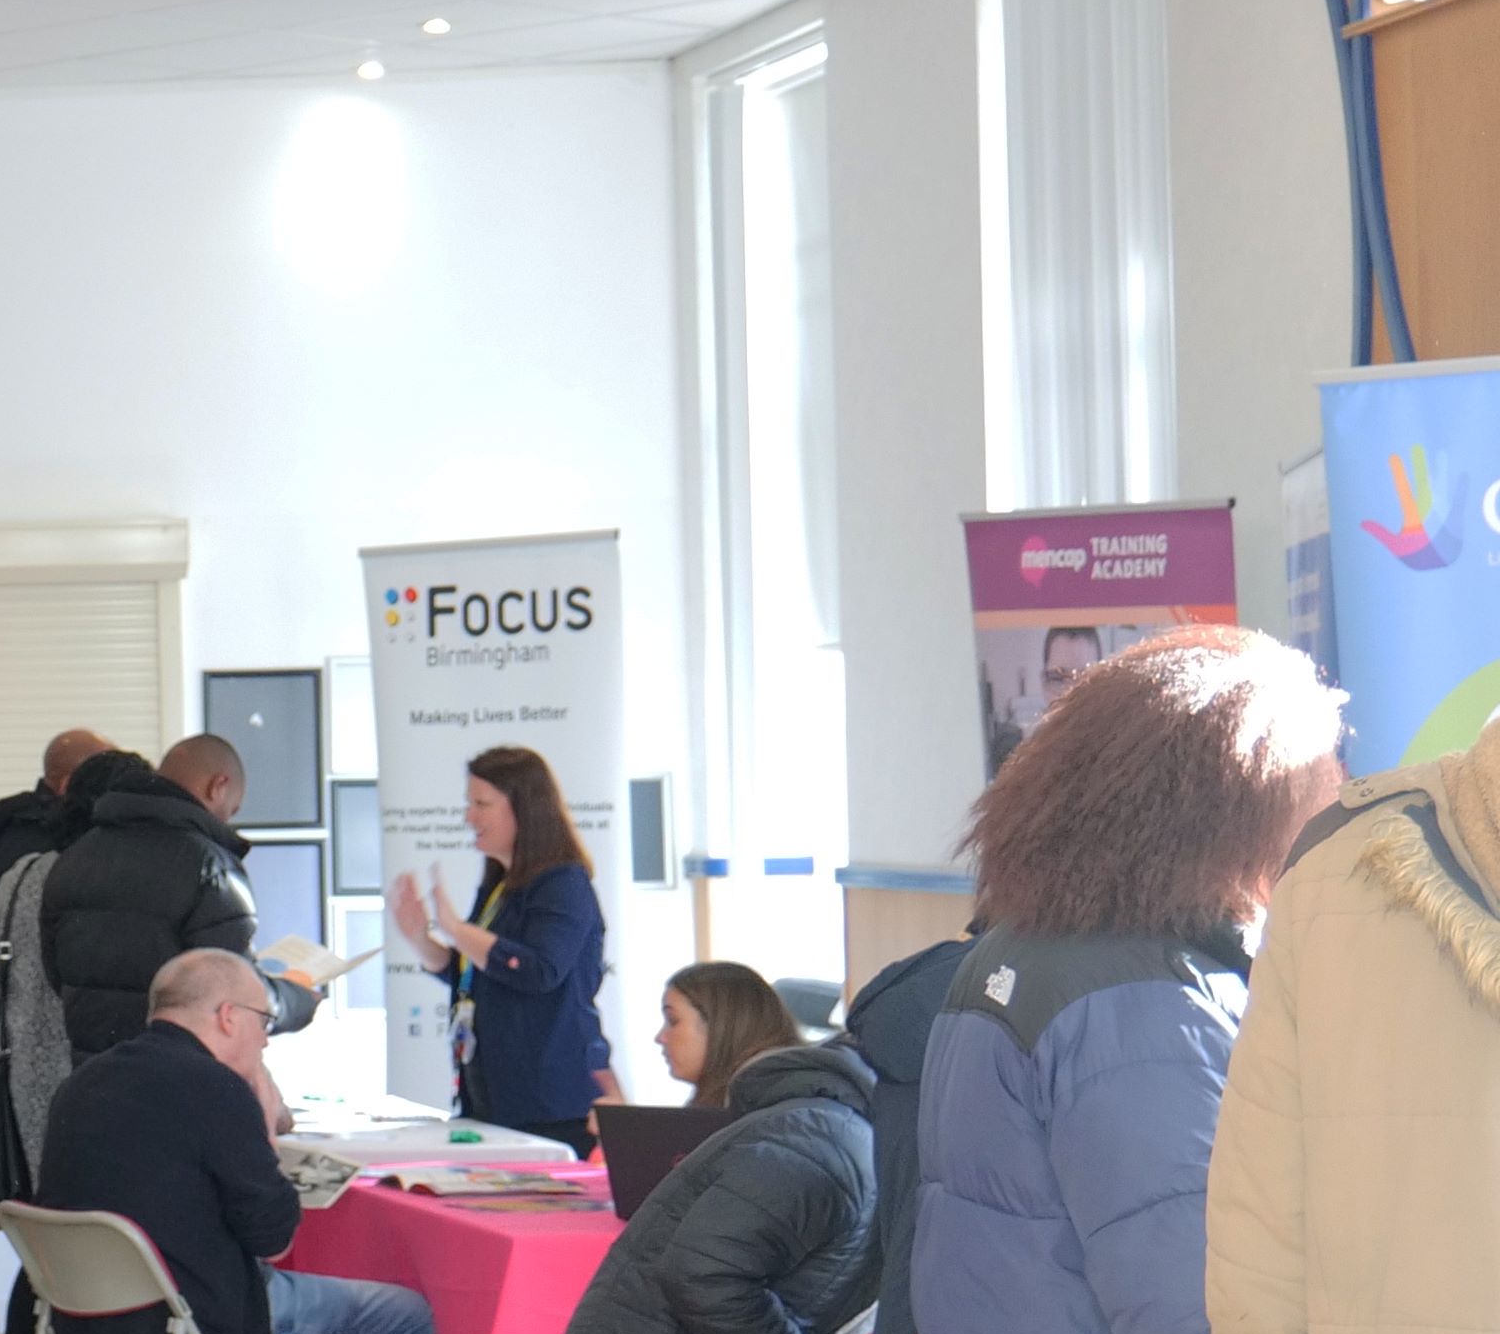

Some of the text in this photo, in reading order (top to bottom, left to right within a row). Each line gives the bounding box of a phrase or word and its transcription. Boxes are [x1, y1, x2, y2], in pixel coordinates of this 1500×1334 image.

[1090, 534, 1168, 556] TRAINING
[1021, 548, 1087, 572] mencap
[1090, 557, 1168, 580] ACADEMY
[426, 643, 549, 670] Birmingham
[409, 705, 568, 727] Making Lives Better
